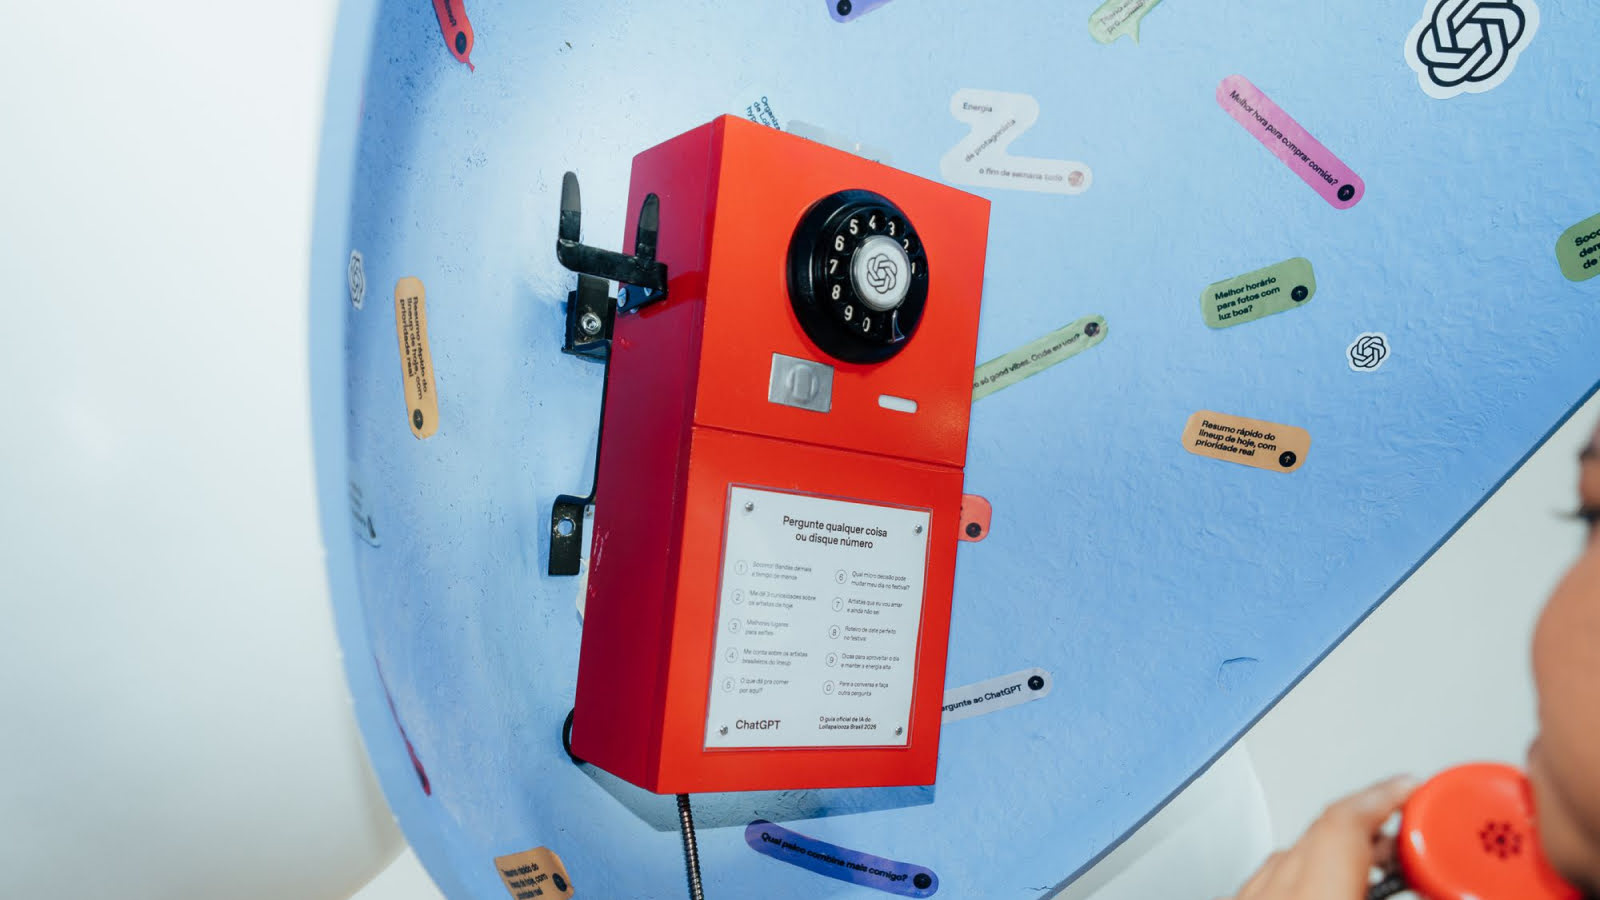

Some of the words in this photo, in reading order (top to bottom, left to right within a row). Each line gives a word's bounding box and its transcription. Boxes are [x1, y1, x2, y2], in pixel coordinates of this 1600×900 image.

[753, 102, 761, 112] de
[962, 102, 993, 113] Energia
[1229, 90, 1254, 114] Melhor
[1252, 110, 1268, 127] hora
[1265, 124, 1283, 140] para
[1281, 136, 1311, 163] comprar
[1308, 160, 1339, 186] comida?
[986, 167, 999, 175] fim
[1000, 169, 1010, 177] de
[849, 218, 859, 235] 5
[868, 215, 876, 230] 4
[888, 221, 895, 236] 3
[834, 235, 845, 251] 6
[829, 258, 839, 274] 7
[911, 261, 916, 274] 1
[1583, 258, 1598, 269] de
[831, 284, 841, 300] 8
[1214, 286, 1245, 301] Melhor
[1245, 276, 1277, 292] horário
[1216, 300, 1236, 312] para
[1236, 292, 1260, 304] fotos
[1260, 286, 1280, 298] com
[843, 304, 853, 321] 9
[1218, 311, 1231, 321] luz
[1232, 304, 1253, 317] boa?
[400, 299, 409, 356] prioridade
[862, 316, 871, 332] 0
[410, 333, 415, 347] de
[417, 343, 425, 377] rápido
[422, 379, 427, 392] do
[989, 366, 1009, 382] good
[1031, 348, 1052, 360] Onde
[1052, 343, 1062, 352] eu
[1201, 419, 1236, 434] Resumo
[1236, 428, 1263, 439] rápido
[1264, 432, 1276, 442] do
[1195, 439, 1238, 454] prioridade
[1238, 447, 1256, 457] real
[1198, 429, 1224, 442] lineup
[1224, 434, 1236, 444] de
[1236, 436, 1256, 448] hoje,
[1257, 442, 1277, 452] com
[783, 515, 824, 530] Pergunte
[825, 523, 864, 535] qualquer
[865, 526, 888, 538] coisa
[795, 533, 807, 541] ou
[808, 533, 838, 546] disque
[840, 537, 874, 549] número
[838, 573, 844, 581] 6
[835, 600, 841, 609] 7
[832, 628, 837, 636] 8
[829, 656, 834, 664] 9
[941, 699, 972, 712] ergunte
[973, 696, 984, 704] ao
[984, 684, 1022, 701] ChatGPT
[735, 719, 781, 730] ChatGPT
[761, 832, 782, 846] Qual
[846, 860, 868, 872] mais
[868, 867, 908, 882] comigo?
